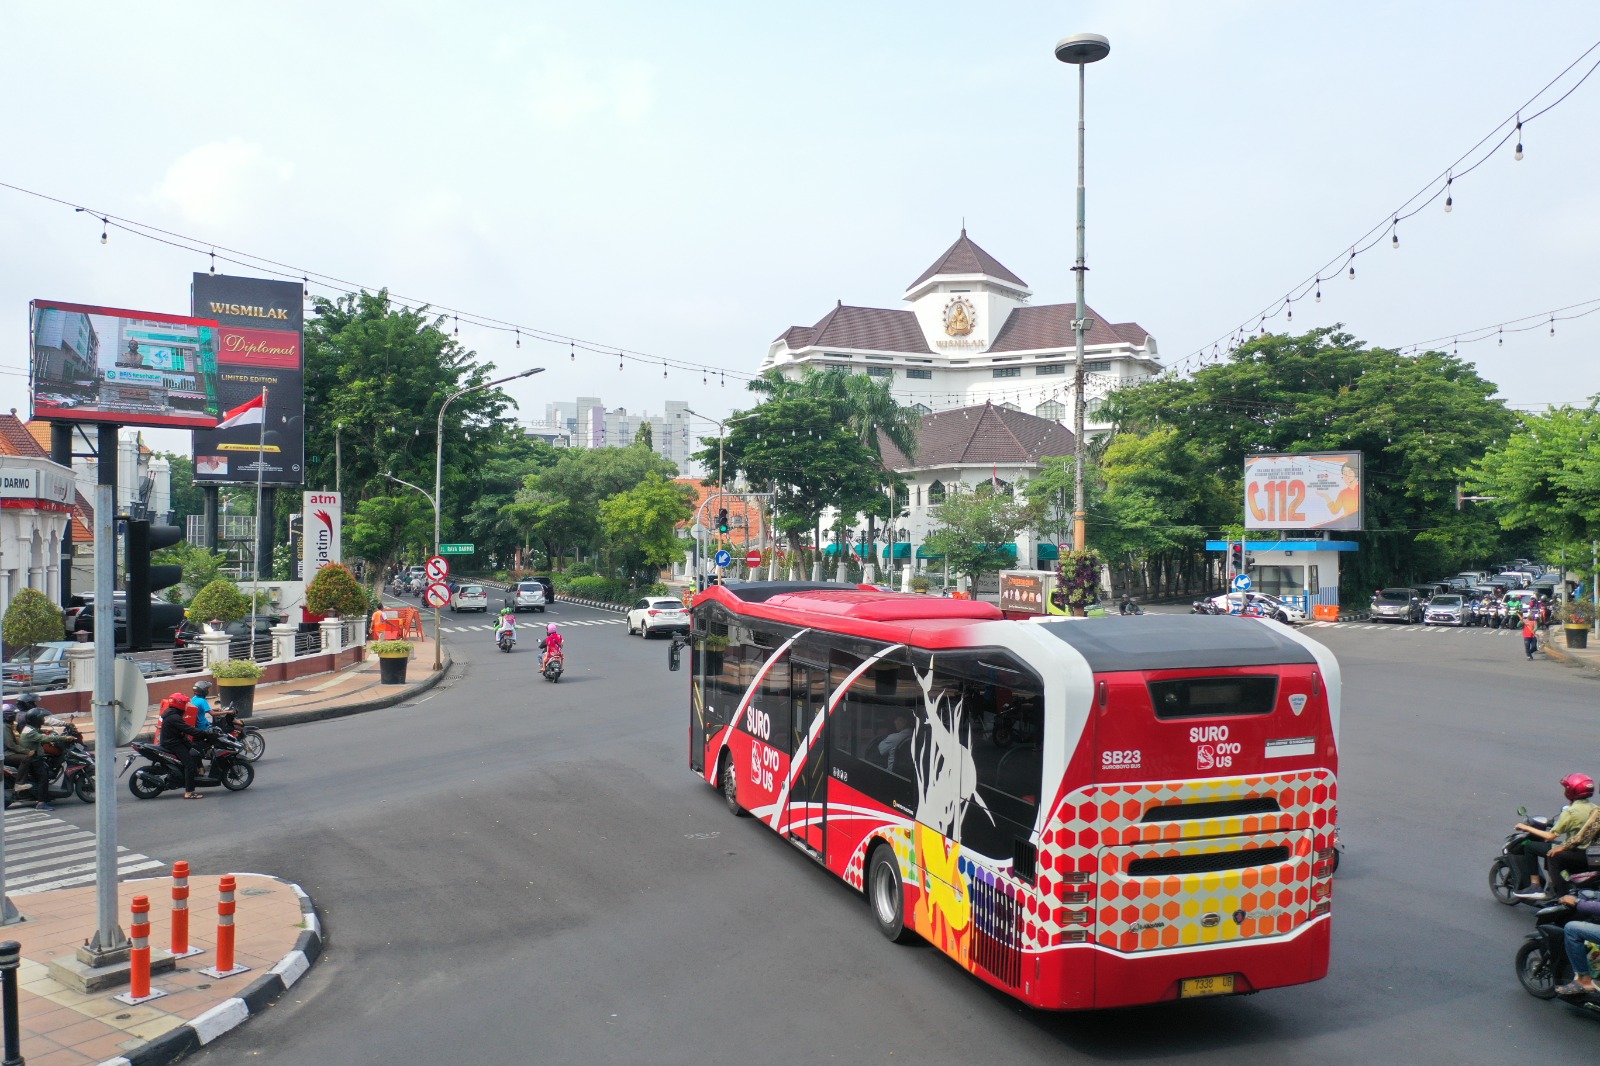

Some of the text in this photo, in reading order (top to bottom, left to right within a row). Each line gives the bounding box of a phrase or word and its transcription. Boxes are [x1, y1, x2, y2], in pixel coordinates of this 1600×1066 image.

[209, 302, 288, 320] WISMILAK
[223, 333, 295, 357] Diplomat
[221, 374, 278, 384] LIMITED EDITION
[4, 477, 30, 489] DARMO
[310, 494, 337, 504] atm
[1263, 479, 1306, 522] 112
[315, 529, 330, 570] kjatim
[746, 705, 771, 741] SURO
[1189, 725, 1229, 743] SURO
[1101, 749, 1141, 765] SB23
[1216, 742, 1241, 755] OYO
[763, 745, 780, 772] OYO
[1215, 755, 1232, 768] US
[762, 770, 774, 793] US
